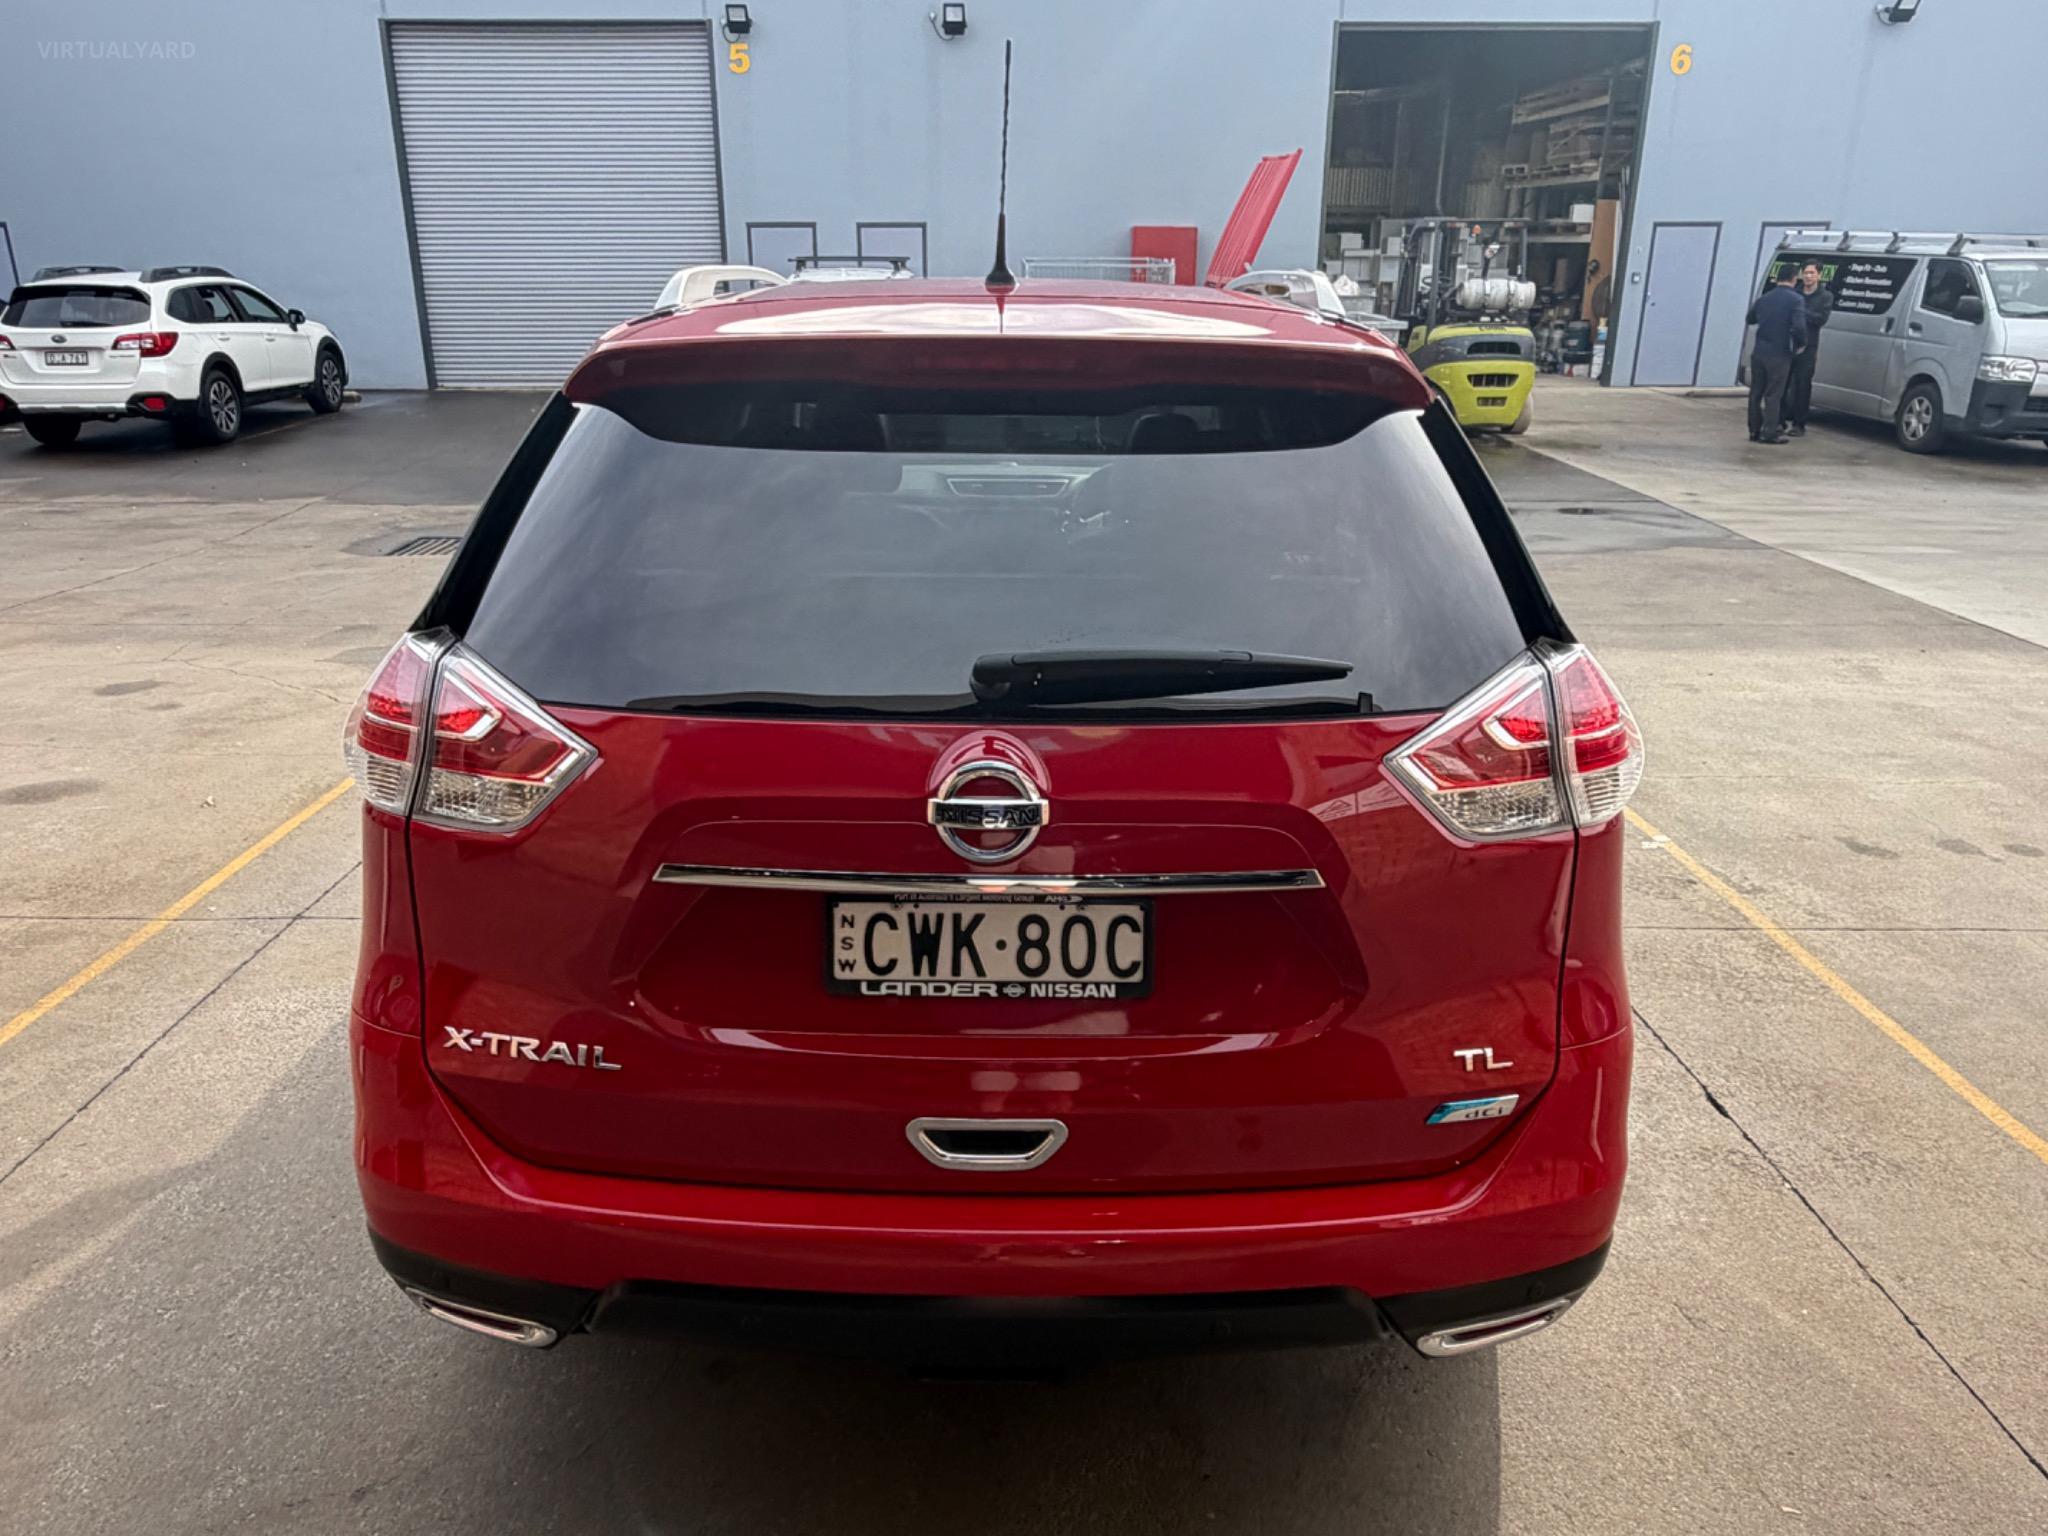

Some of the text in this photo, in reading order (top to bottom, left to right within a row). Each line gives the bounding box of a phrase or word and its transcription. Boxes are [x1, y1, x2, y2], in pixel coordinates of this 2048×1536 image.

[729, 43, 751, 74] 5
[1670, 43, 1692, 76] 6
[940, 805, 1040, 827] NISSAN
[860, 981, 1117, 998] LANDER NISSAN
[443, 1025, 623, 1071] X-TRAIL
[1453, 1047, 1514, 1072] TL
